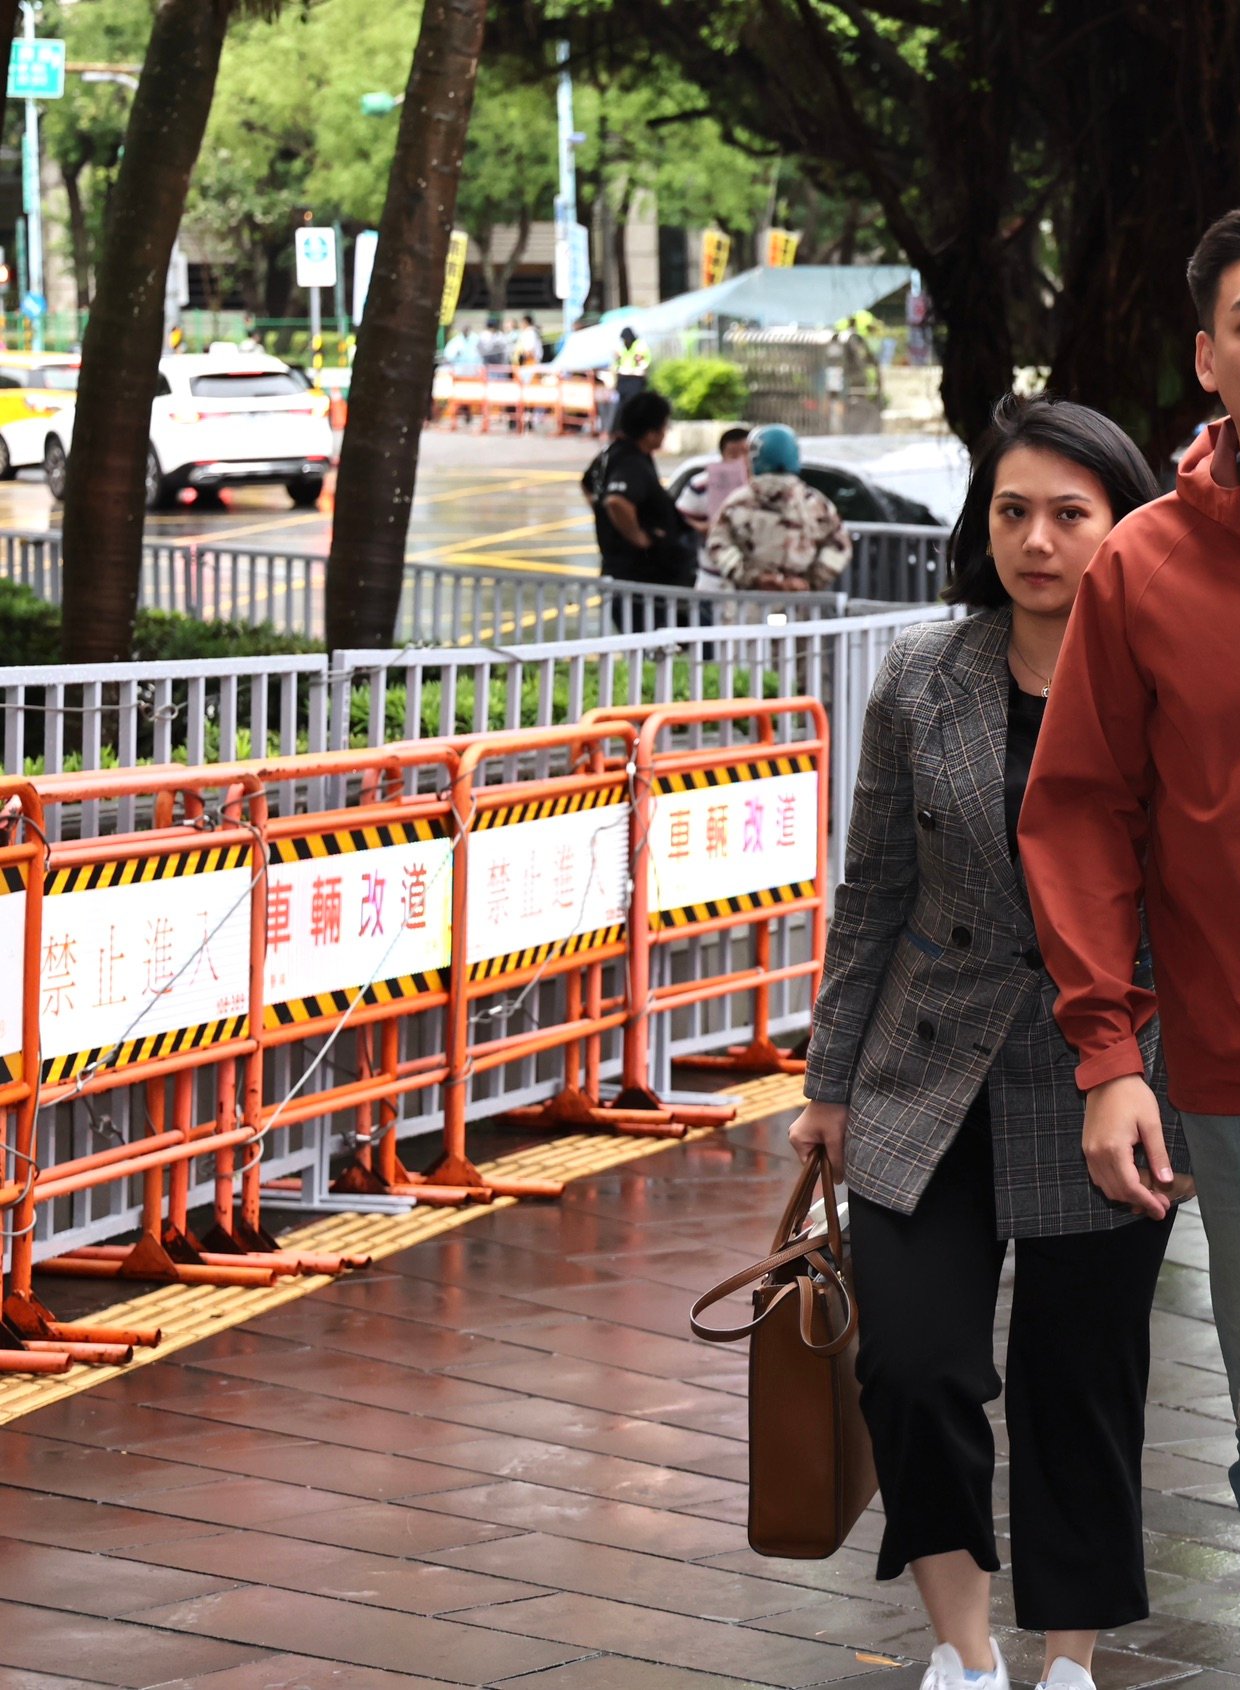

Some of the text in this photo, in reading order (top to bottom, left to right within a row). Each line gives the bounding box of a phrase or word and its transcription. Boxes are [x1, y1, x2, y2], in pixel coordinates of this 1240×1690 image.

[668, 793, 797, 863] 車輛改道
[267, 862, 427, 953] 車輛改道
[40, 910, 219, 1017] 禁止進入
